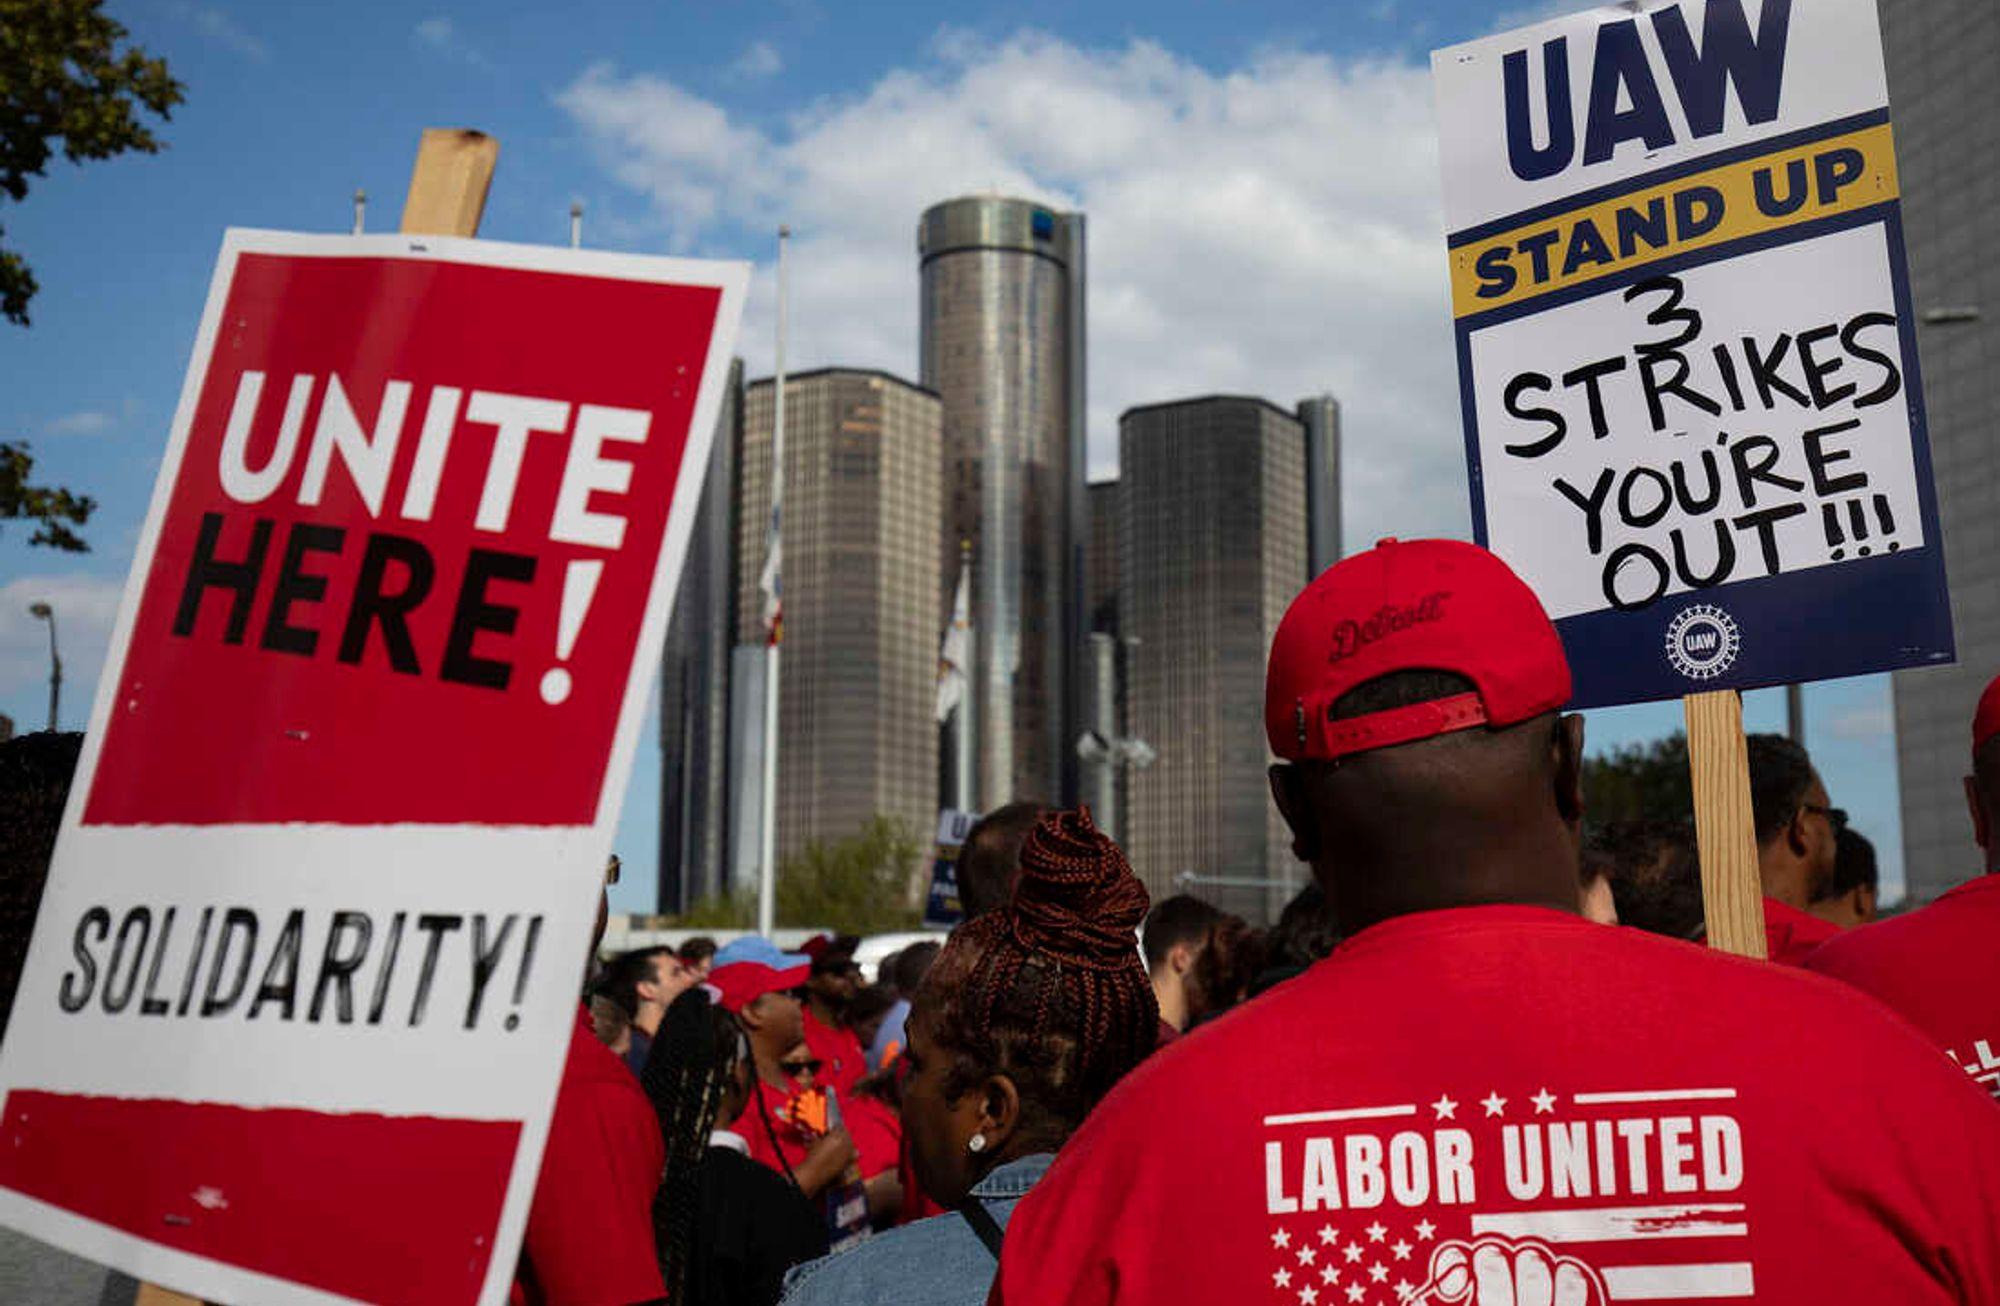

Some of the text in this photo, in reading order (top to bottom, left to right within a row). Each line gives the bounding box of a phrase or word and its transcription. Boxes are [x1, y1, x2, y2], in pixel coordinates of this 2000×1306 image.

[1503, 0, 1791, 182] UAW
[1475, 147, 1865, 299] STAND UP
[1503, 313, 1900, 458] STRIKES
[1624, 276, 1702, 356] 3
[218, 369, 653, 549] UNITE
[1553, 419, 1867, 554] YOU'RE
[172, 514, 604, 706] HERE!
[1685, 632, 1717, 652] UAW
[59, 906, 545, 1033] SOLIDARITY!
[1264, 1115, 1744, 1214] LABOR UNITED
